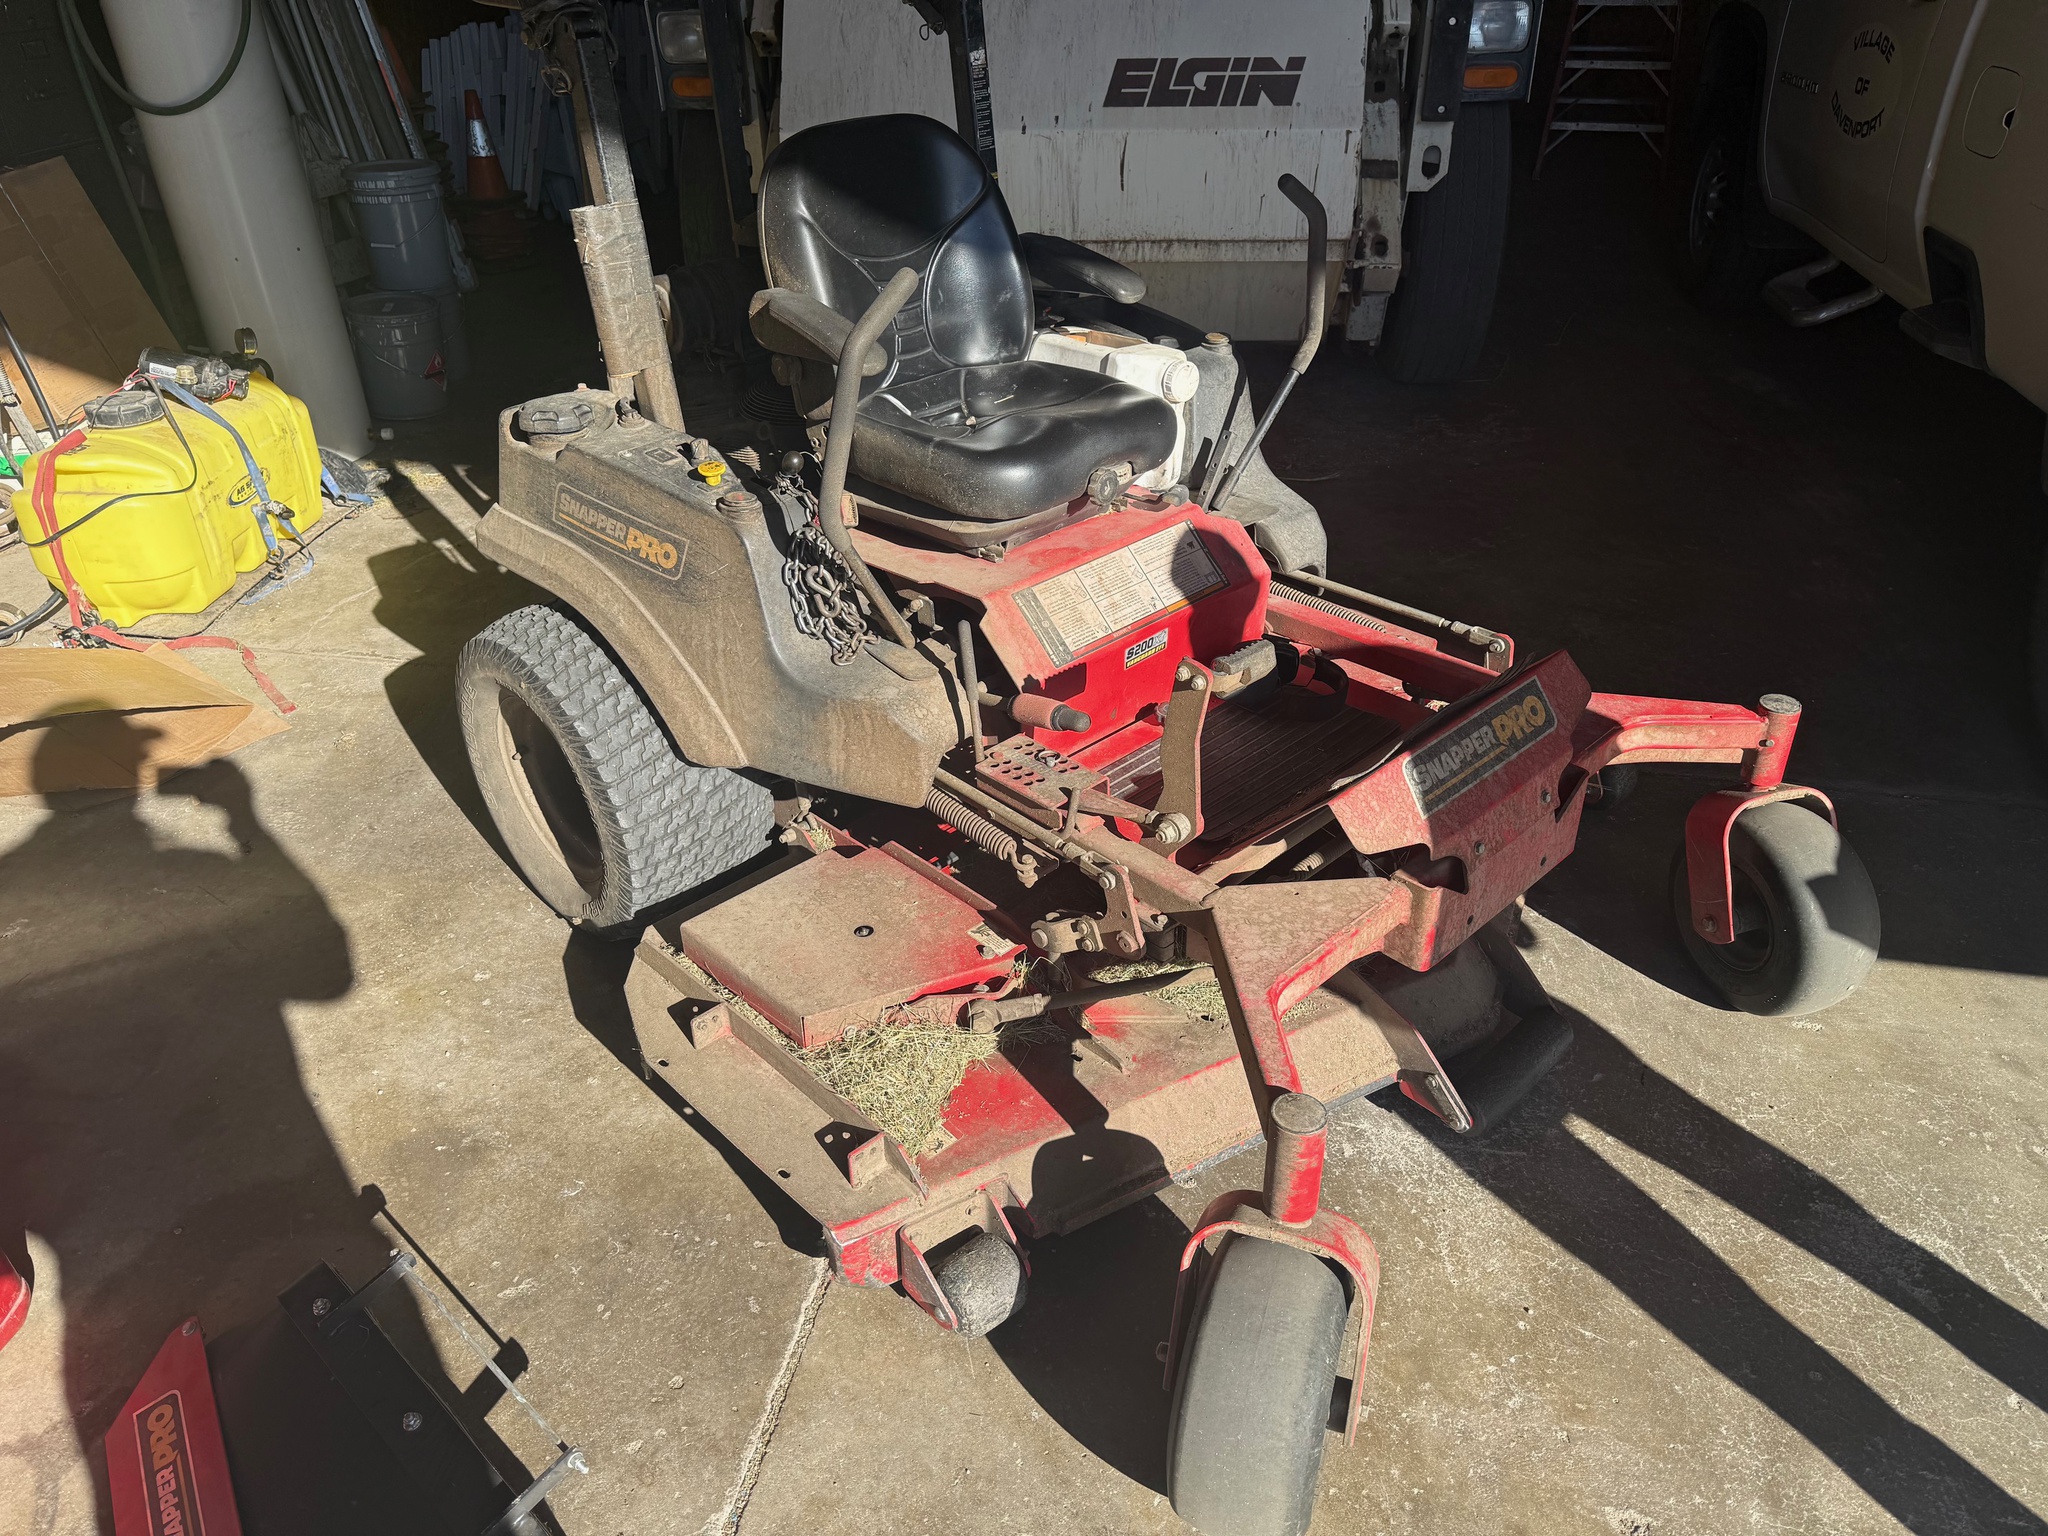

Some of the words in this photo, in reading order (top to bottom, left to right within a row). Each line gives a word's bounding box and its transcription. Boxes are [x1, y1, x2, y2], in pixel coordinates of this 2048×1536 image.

[1853, 29, 1895, 63] VILLAGE
[1102, 56, 1307, 108] ELGIN
[1854, 77, 1870, 96] OF
[1831, 90, 1885, 139] DAVENPORT
[558, 492, 629, 541] SNAPPER
[625, 526, 678, 570] PRO
[460, 680, 499, 810] CARLISLE
[1413, 724, 1499, 792] SNAPPER
[1491, 695, 1546, 746] PRO
[146, 1404, 178, 1471] PRO
